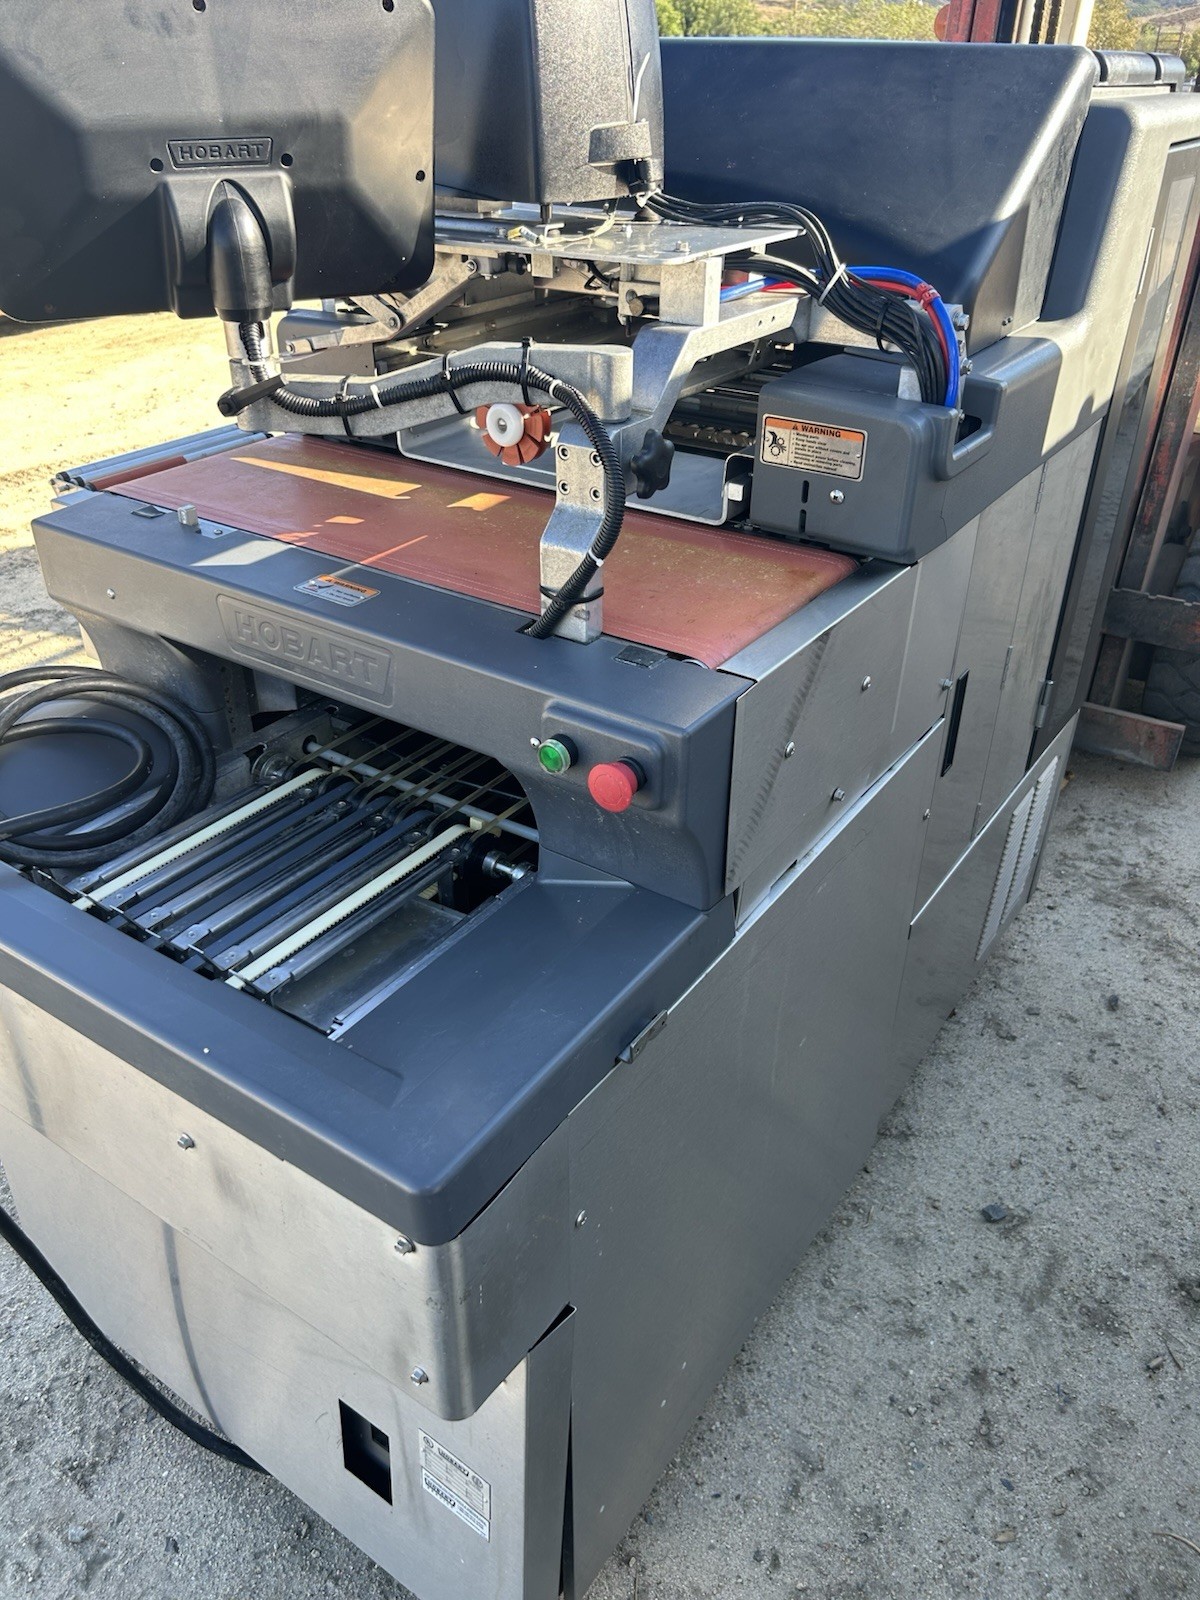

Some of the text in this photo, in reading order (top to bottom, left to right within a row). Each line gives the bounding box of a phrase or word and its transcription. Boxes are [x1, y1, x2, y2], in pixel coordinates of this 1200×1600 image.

[178, 144, 264, 161] HOBART
[801, 425, 841, 438] WARNING
[235, 611, 378, 685] HOBART
